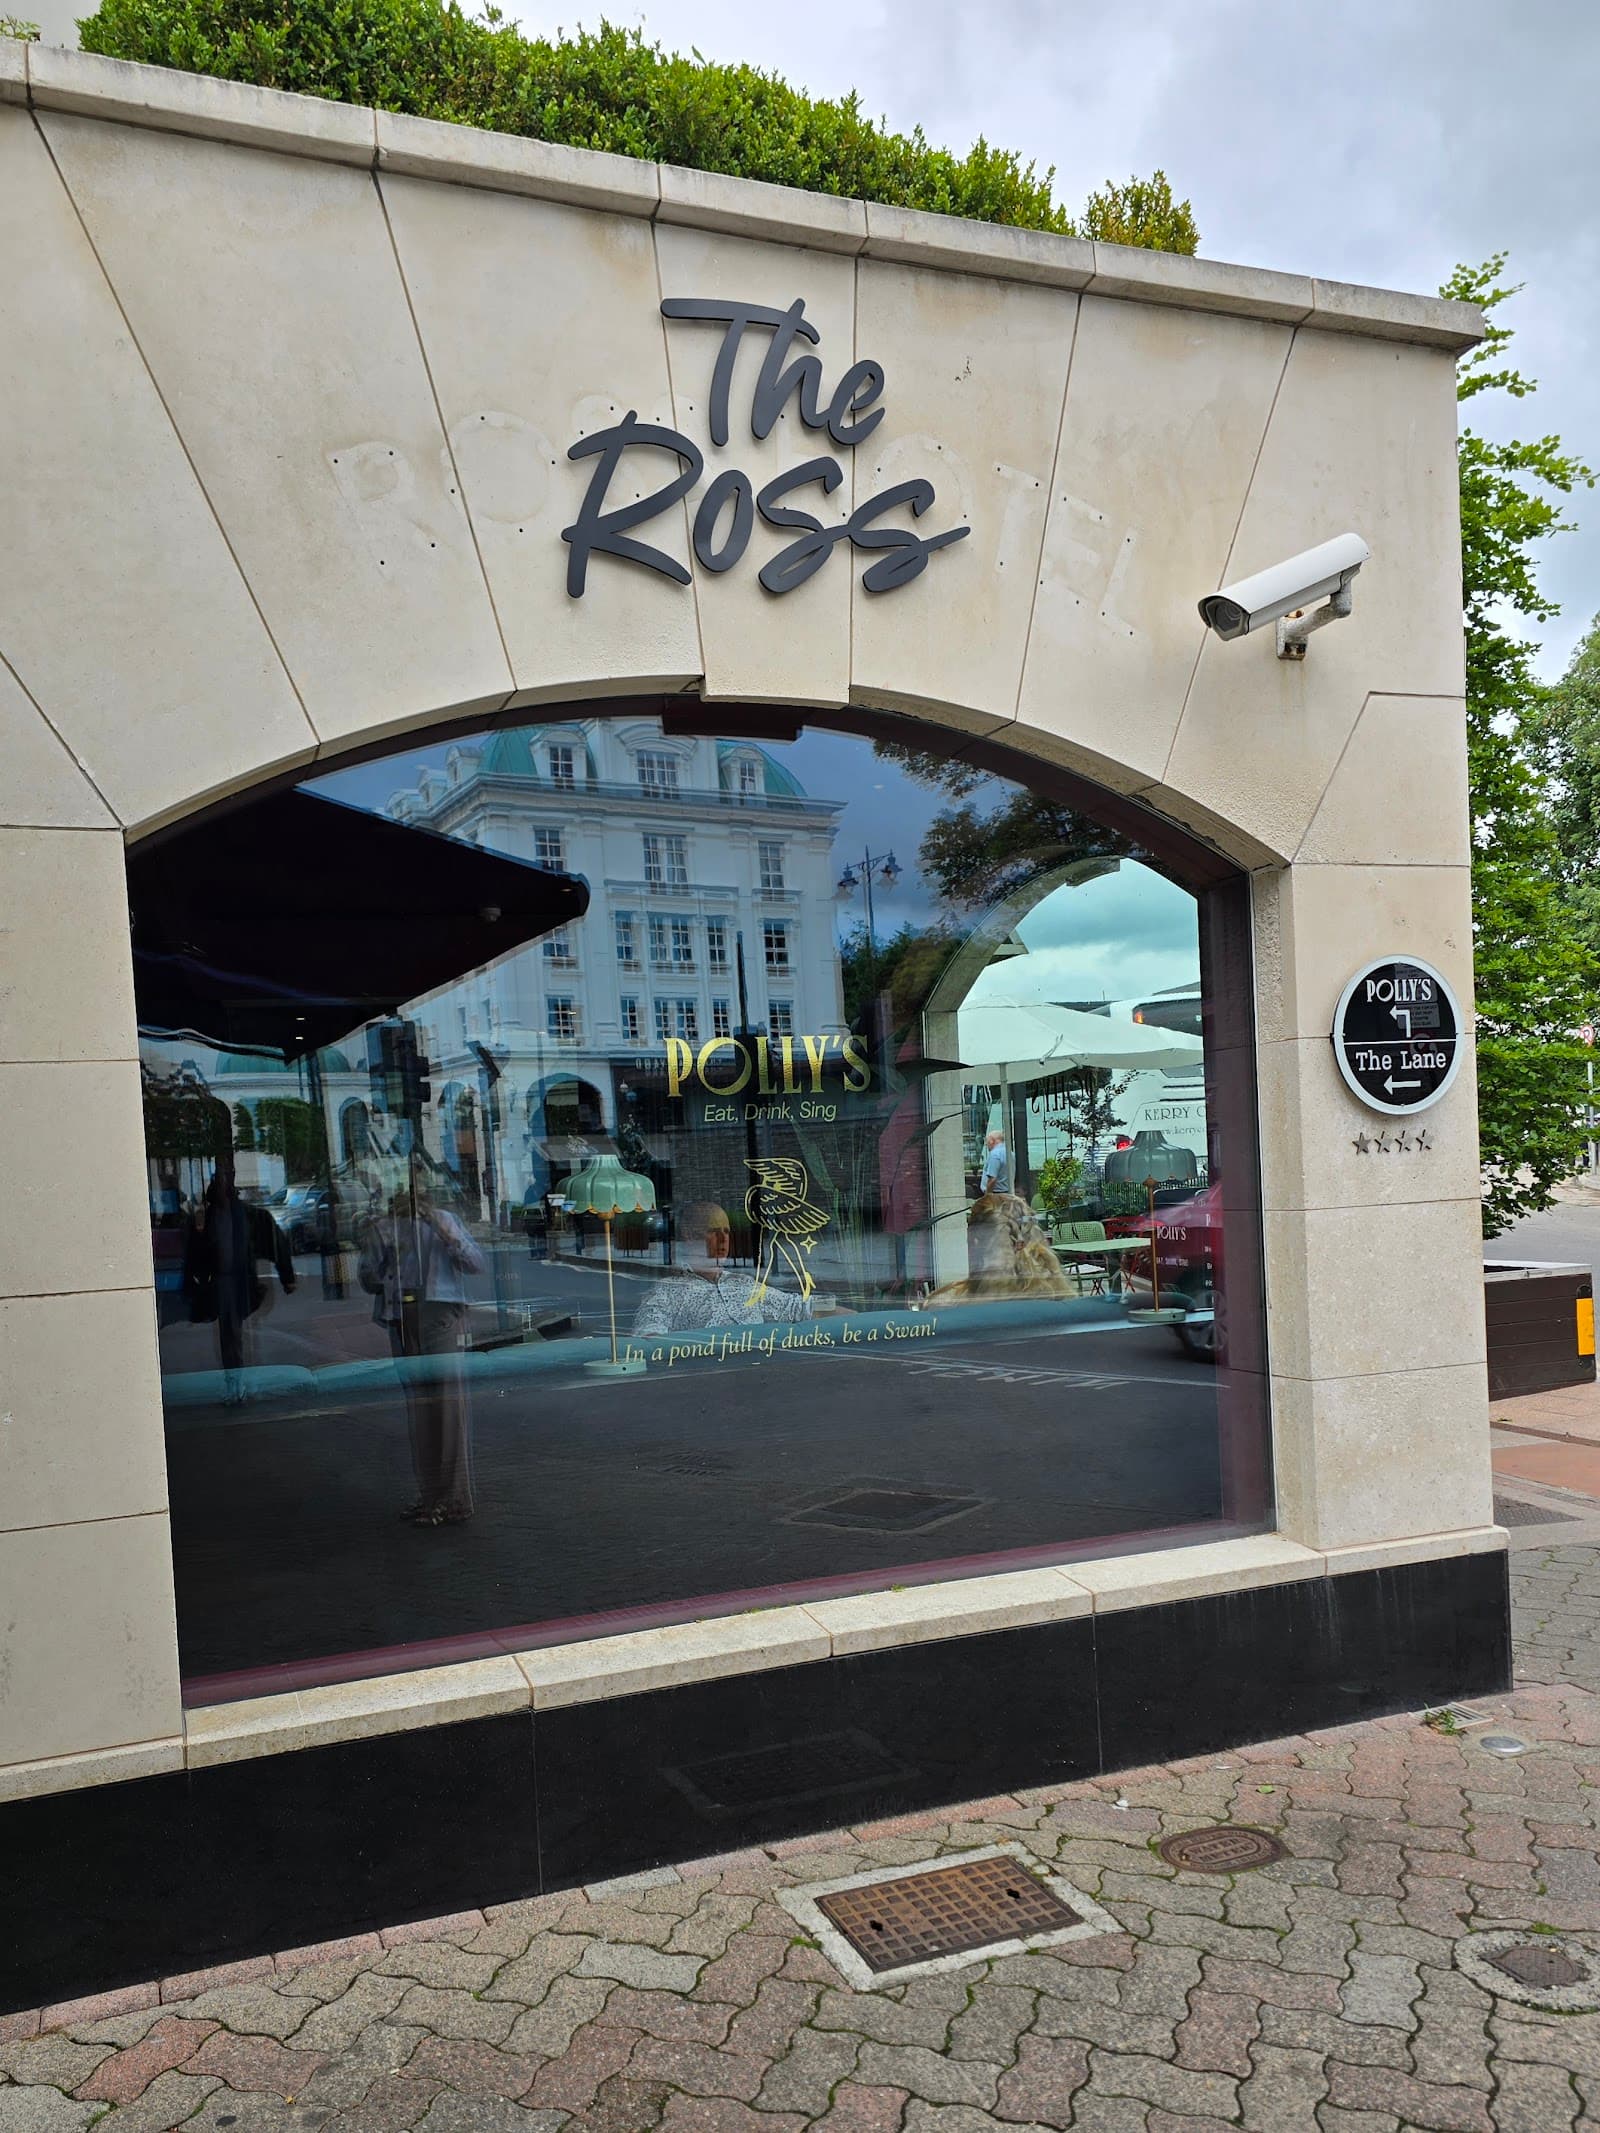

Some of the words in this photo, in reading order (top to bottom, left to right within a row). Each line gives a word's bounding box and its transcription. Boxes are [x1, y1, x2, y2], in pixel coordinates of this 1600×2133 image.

[660, 298, 886, 448] The
[561, 410, 971, 599] Ross
[1366, 978, 1433, 1003] POLLY'S
[663, 1034, 872, 1098] POLLY'S
[1355, 1049, 1392, 1071] The
[1400, 1050, 1447, 1070] Lane
[703, 1104, 739, 1123] Eat,
[744, 1101, 794, 1121] Drink,
[799, 1100, 837, 1122] Sing
[1144, 1106, 1190, 1121] KERRY
[625, 1343, 646, 1363] In
[651, 1350, 663, 1363] a
[668, 1334, 717, 1367] pond
[717, 1330, 753, 1362] full
[758, 1327, 779, 1357] of
[781, 1327, 836, 1350] ducks,
[842, 1322, 861, 1343] be
[867, 1328, 878, 1342] a
[884, 1317, 938, 1341] Swan!
